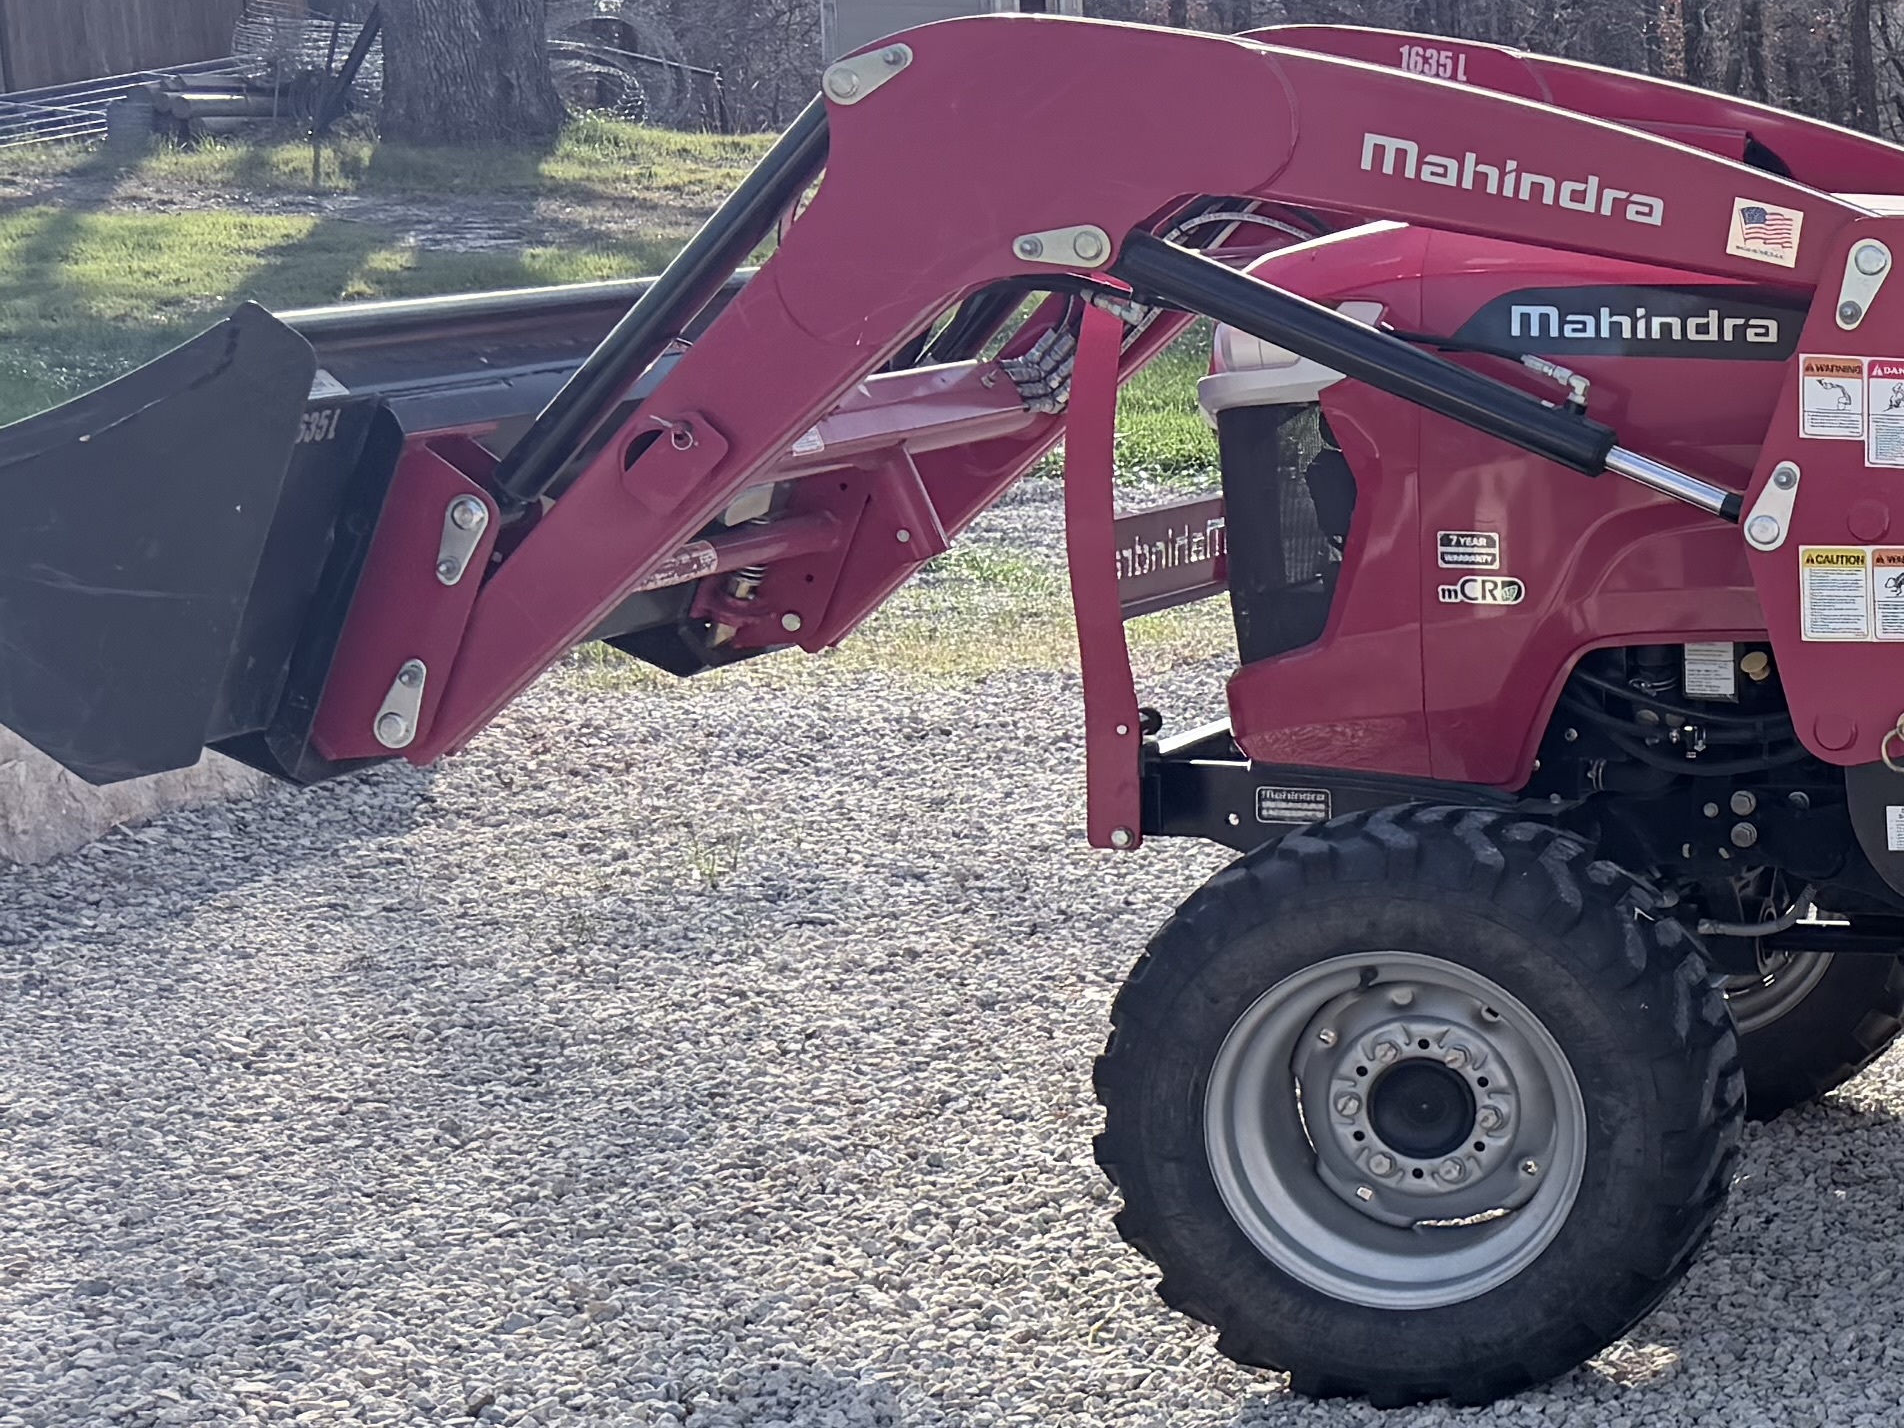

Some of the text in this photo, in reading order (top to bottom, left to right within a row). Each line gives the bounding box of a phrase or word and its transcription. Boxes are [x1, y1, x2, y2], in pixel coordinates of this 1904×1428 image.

[1400, 44, 1467, 82] 1635 L
[1360, 132, 1664, 226] Mahindra
[1510, 305, 1779, 343] Mahindra
[1814, 363, 1862, 375] WARNING
[1448, 535, 1487, 547] 7 YEAR
[1815, 554, 1865, 566] CAUTION
